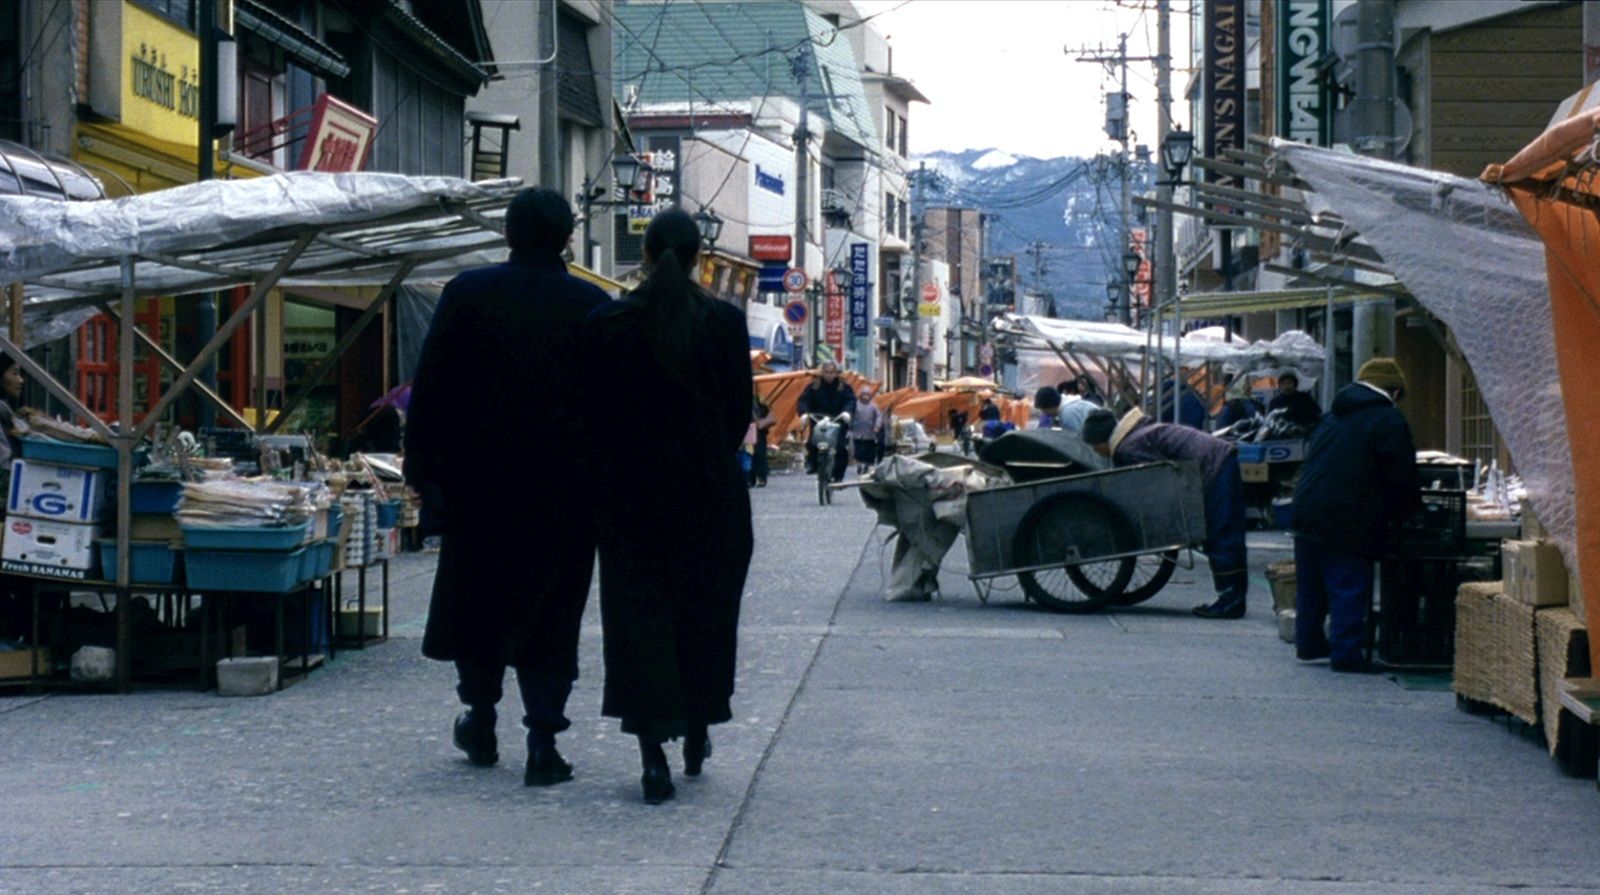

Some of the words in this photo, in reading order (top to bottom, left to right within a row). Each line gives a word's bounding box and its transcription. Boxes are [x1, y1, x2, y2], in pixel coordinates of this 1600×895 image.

[1214, 4, 1235, 92] NAGAI
[132, 55, 175, 111] URUSHI
[32, 493, 67, 515] G
[1, 561, 29, 573] Fresh
[31, 564, 85, 580] BANANAS
